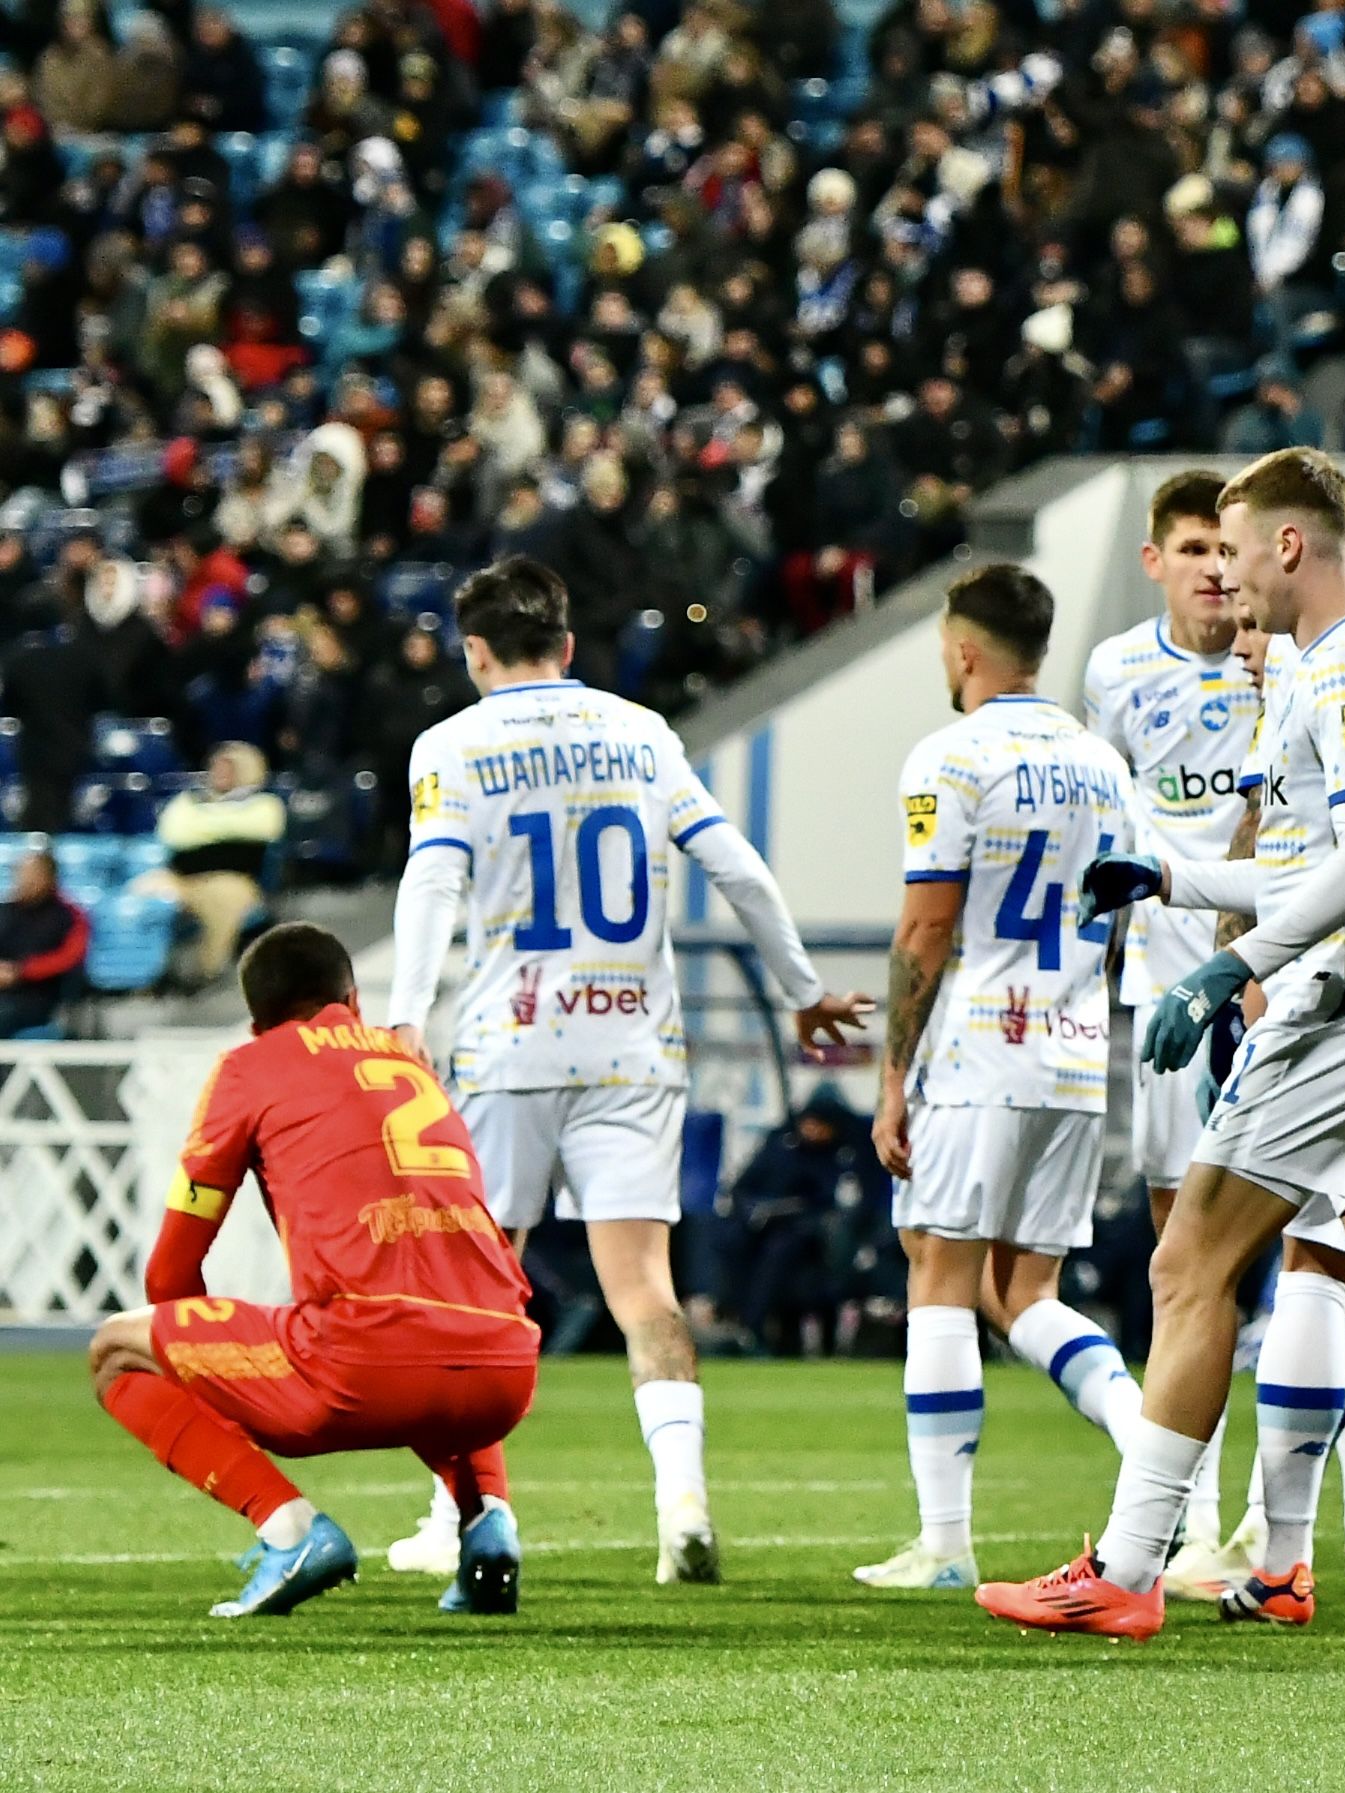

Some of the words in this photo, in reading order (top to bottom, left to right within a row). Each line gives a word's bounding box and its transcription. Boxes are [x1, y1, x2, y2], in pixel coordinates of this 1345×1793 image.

[472, 740, 657, 797] ШАПАРЕНКО
[1157, 764, 1235, 803] aba
[508, 805, 651, 952] 10
[556, 982, 650, 1016] vbet
[354, 1058, 472, 1180] 2
[174, 1298, 236, 1328] 2
